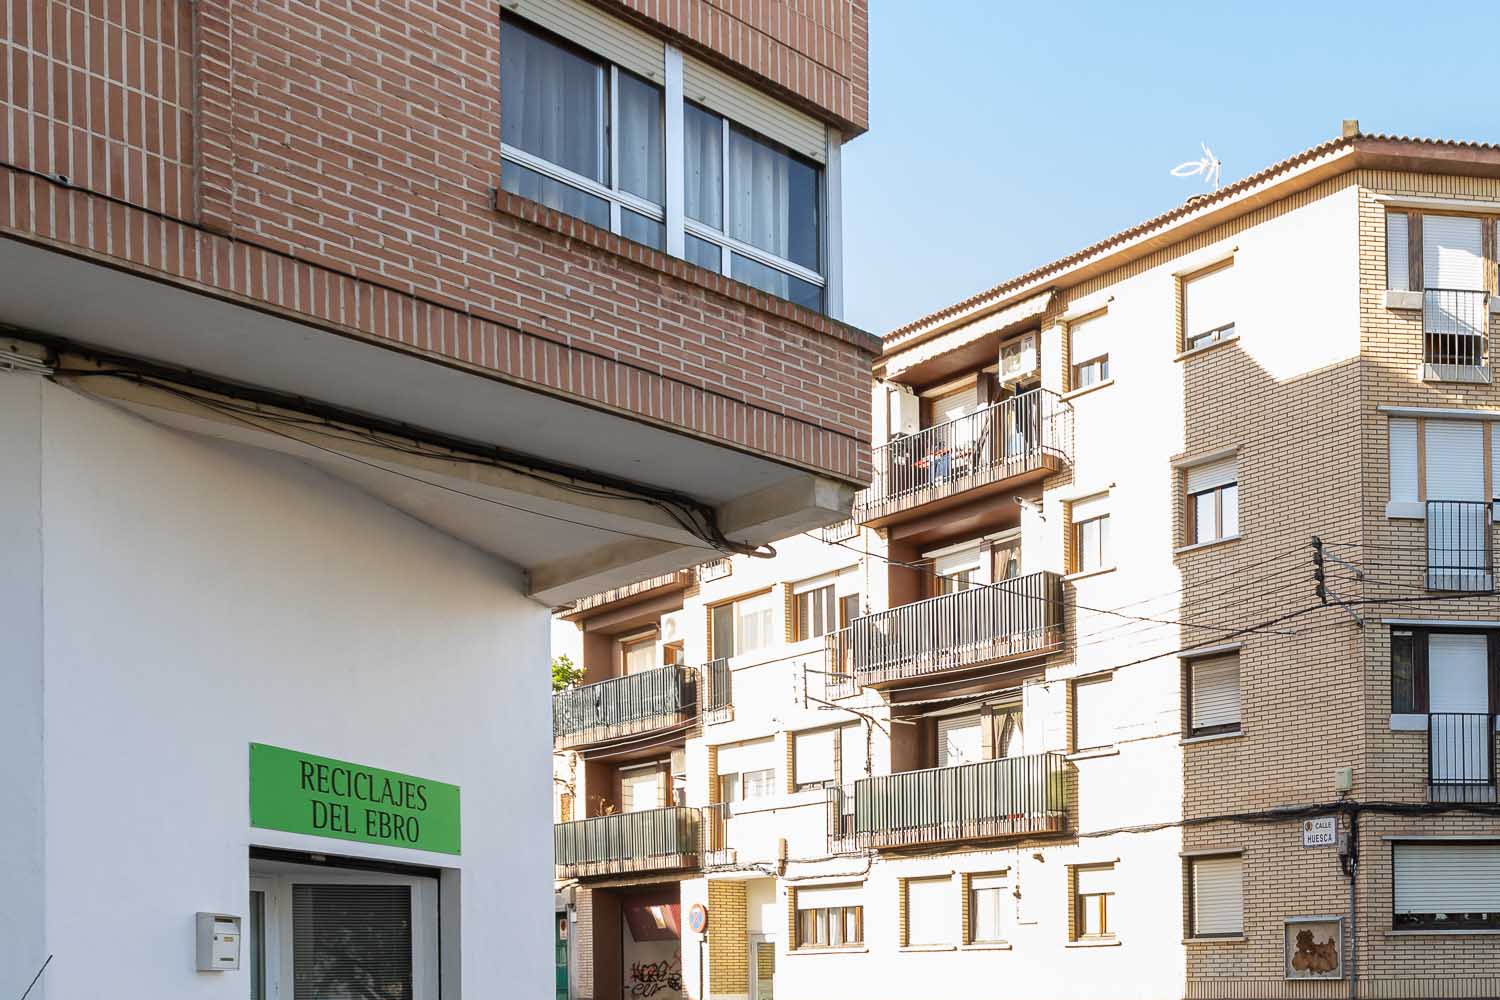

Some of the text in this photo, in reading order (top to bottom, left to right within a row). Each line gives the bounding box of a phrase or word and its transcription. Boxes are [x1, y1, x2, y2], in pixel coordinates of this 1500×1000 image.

[299, 760, 427, 811] RECICLAJES
[311, 800, 420, 843] DEL EBRO
[1315, 821, 1332, 829] CALLE
[1307, 833, 1332, 844] HUESCA
